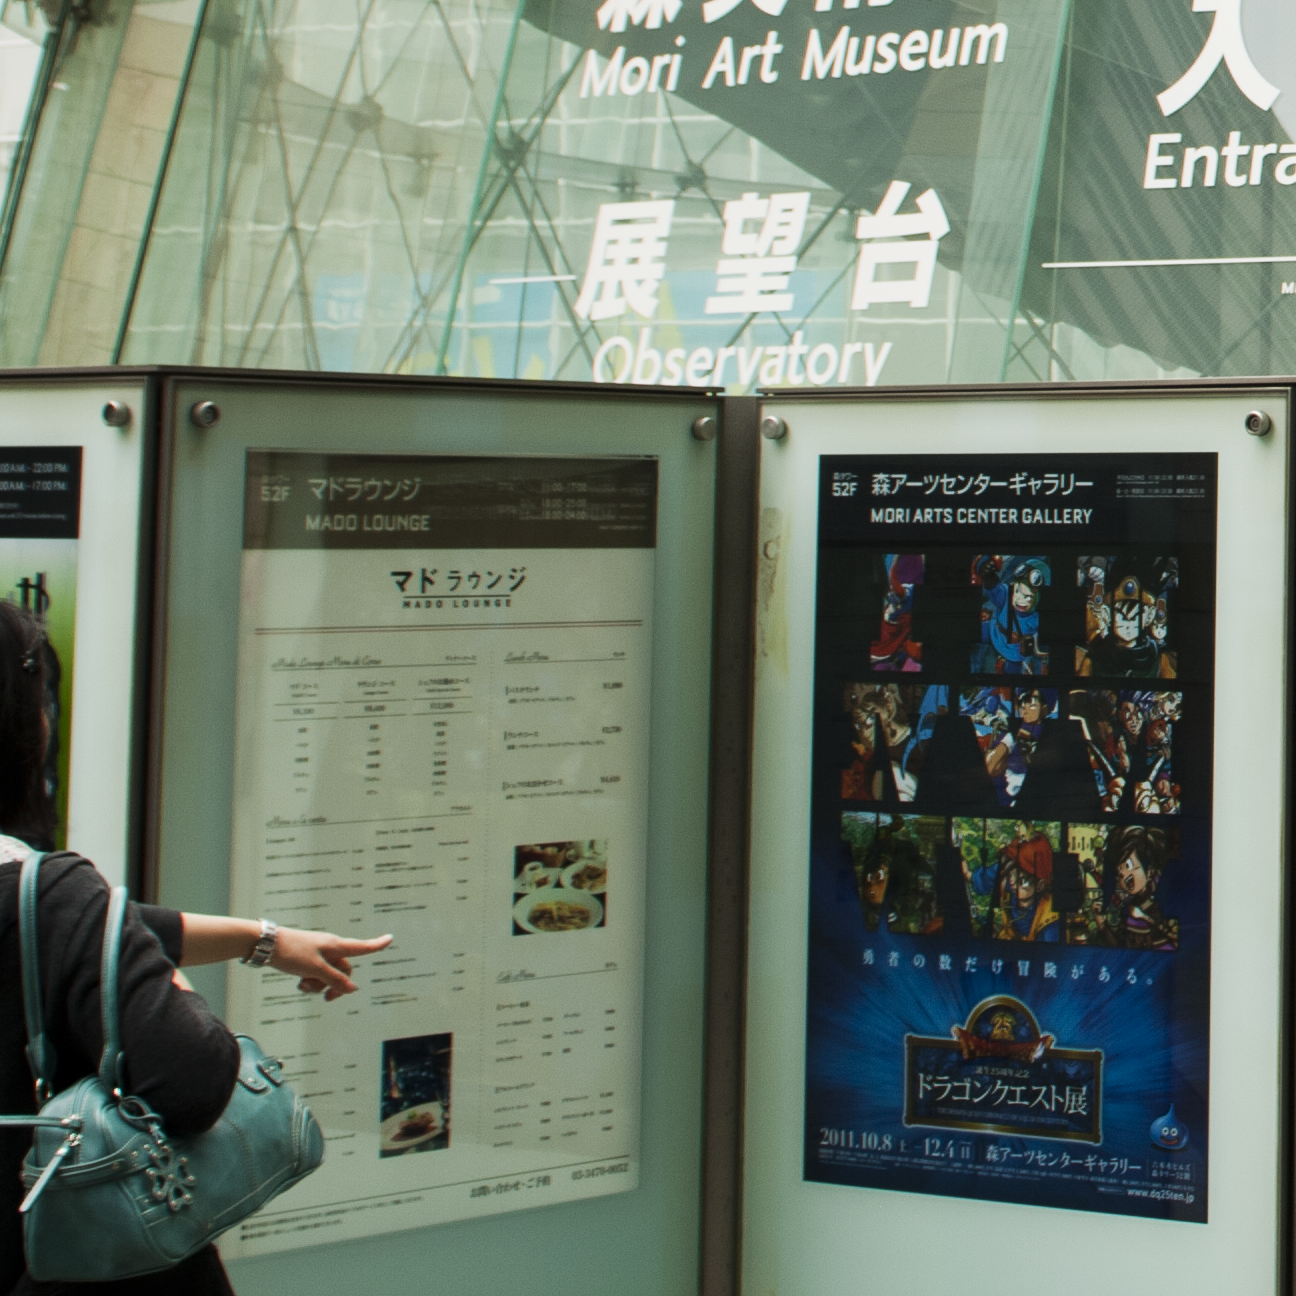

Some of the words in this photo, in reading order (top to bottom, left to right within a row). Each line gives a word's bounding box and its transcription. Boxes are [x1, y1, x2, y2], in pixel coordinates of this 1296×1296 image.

[579, 34, 684, 99] Mori
[701, 30, 784, 90] Art
[801, 22, 1010, 81] Museum
[574, 179, 951, 322] 展望台
[592, 327, 893, 387] Observatory
[260, 485, 292, 502] 52F
[307, 477, 422, 501] マドラウンジ
[831, 482, 858, 497] 52F
[870, 471, 1094, 497] 森アーツセンターギャラリー
[304, 514, 361, 532] MADO
[363, 514, 431, 532] LOUNGE
[870, 508, 910, 525] MORI
[912, 508, 953, 525] ARTS
[956, 508, 1018, 525] CENTER
[1021, 508, 1093, 525] GALLERY
[389, 567, 437, 594] マド
[446, 566, 528, 593] ラウンジ
[402, 599, 444, 609] MADO
[452, 598, 513, 609] LOUNGE
[862, 948, 1154, 986] 勇者の数だけ冒険がある。
[917, 1071, 1089, 1116] ドラゴンクエスト展
[819, 1126, 892, 1153] 2011.10.8
[985, 1144, 1142, 1176] 森アーツセンターギャラリー
